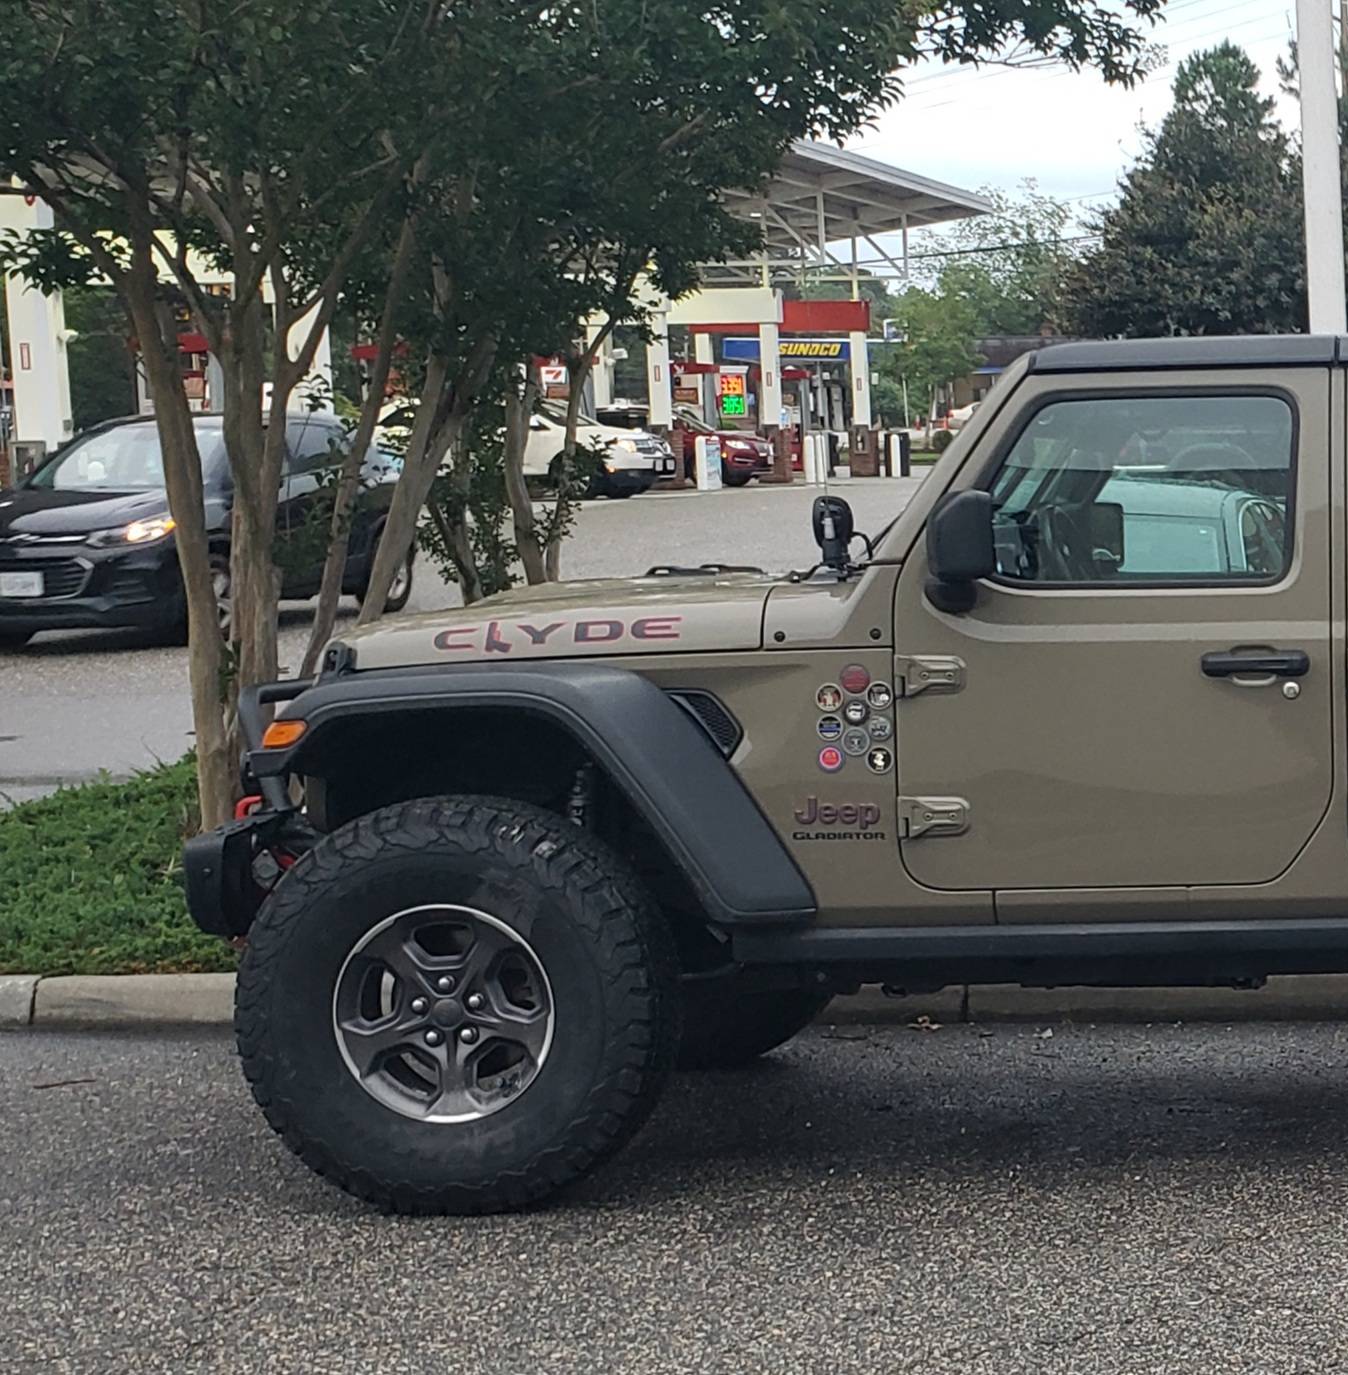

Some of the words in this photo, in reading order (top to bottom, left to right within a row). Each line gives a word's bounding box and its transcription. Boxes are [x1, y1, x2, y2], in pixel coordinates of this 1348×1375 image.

[778, 343, 841, 356] SUNOCO
[433, 616, 683, 653] CLYDE
[794, 795, 880, 830] Jeep
[792, 832, 885, 840] GLADIATOR
